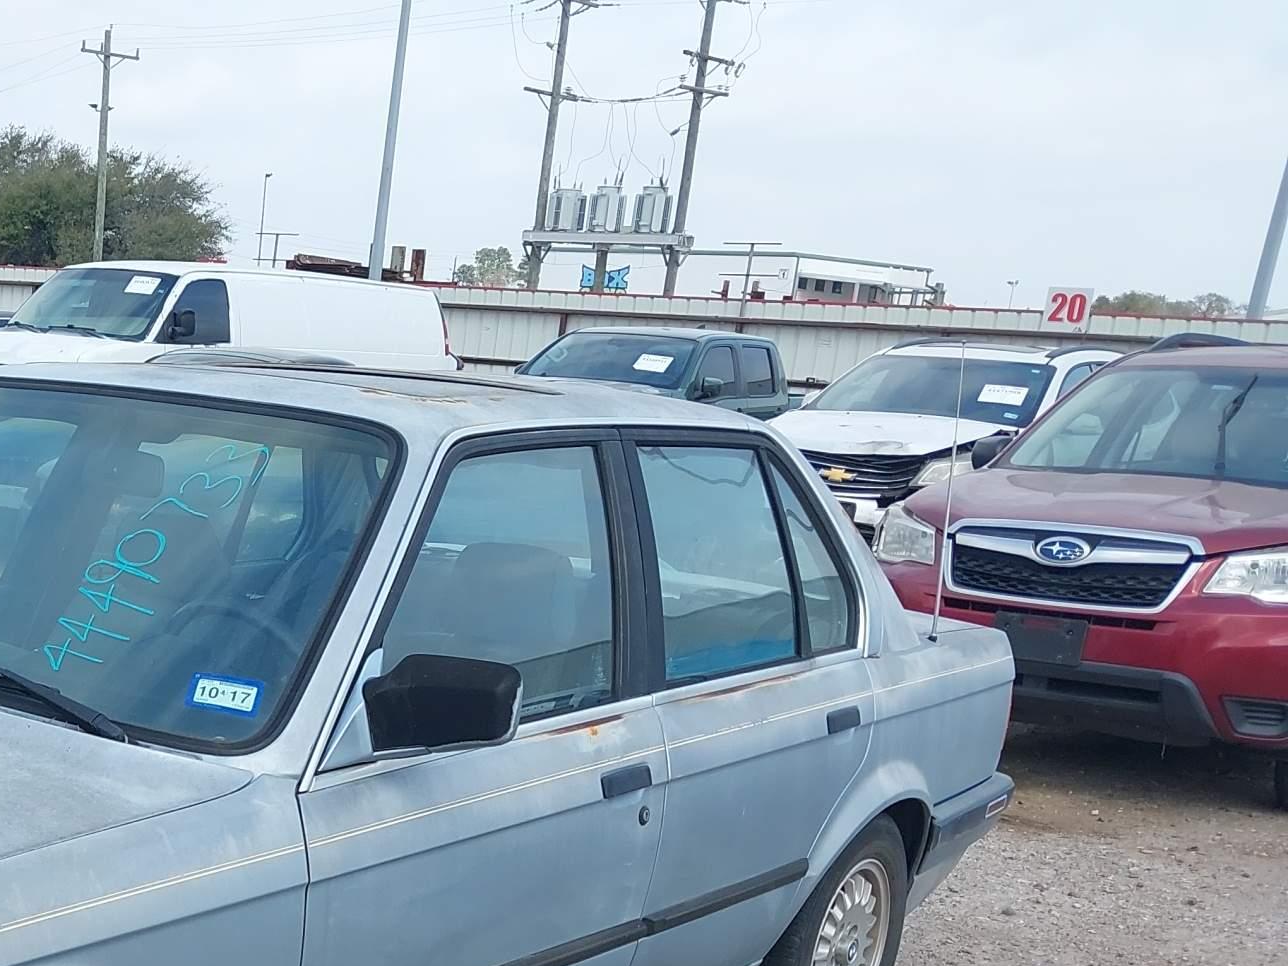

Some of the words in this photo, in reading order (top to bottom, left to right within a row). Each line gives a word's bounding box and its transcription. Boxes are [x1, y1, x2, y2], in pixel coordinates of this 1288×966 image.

[580, 264, 631, 289] BX
[1047, 292, 1087, 323] 20
[43, 444, 270, 672] 44490733
[199, 685, 220, 699] 10
[230, 690, 252, 704] 17
